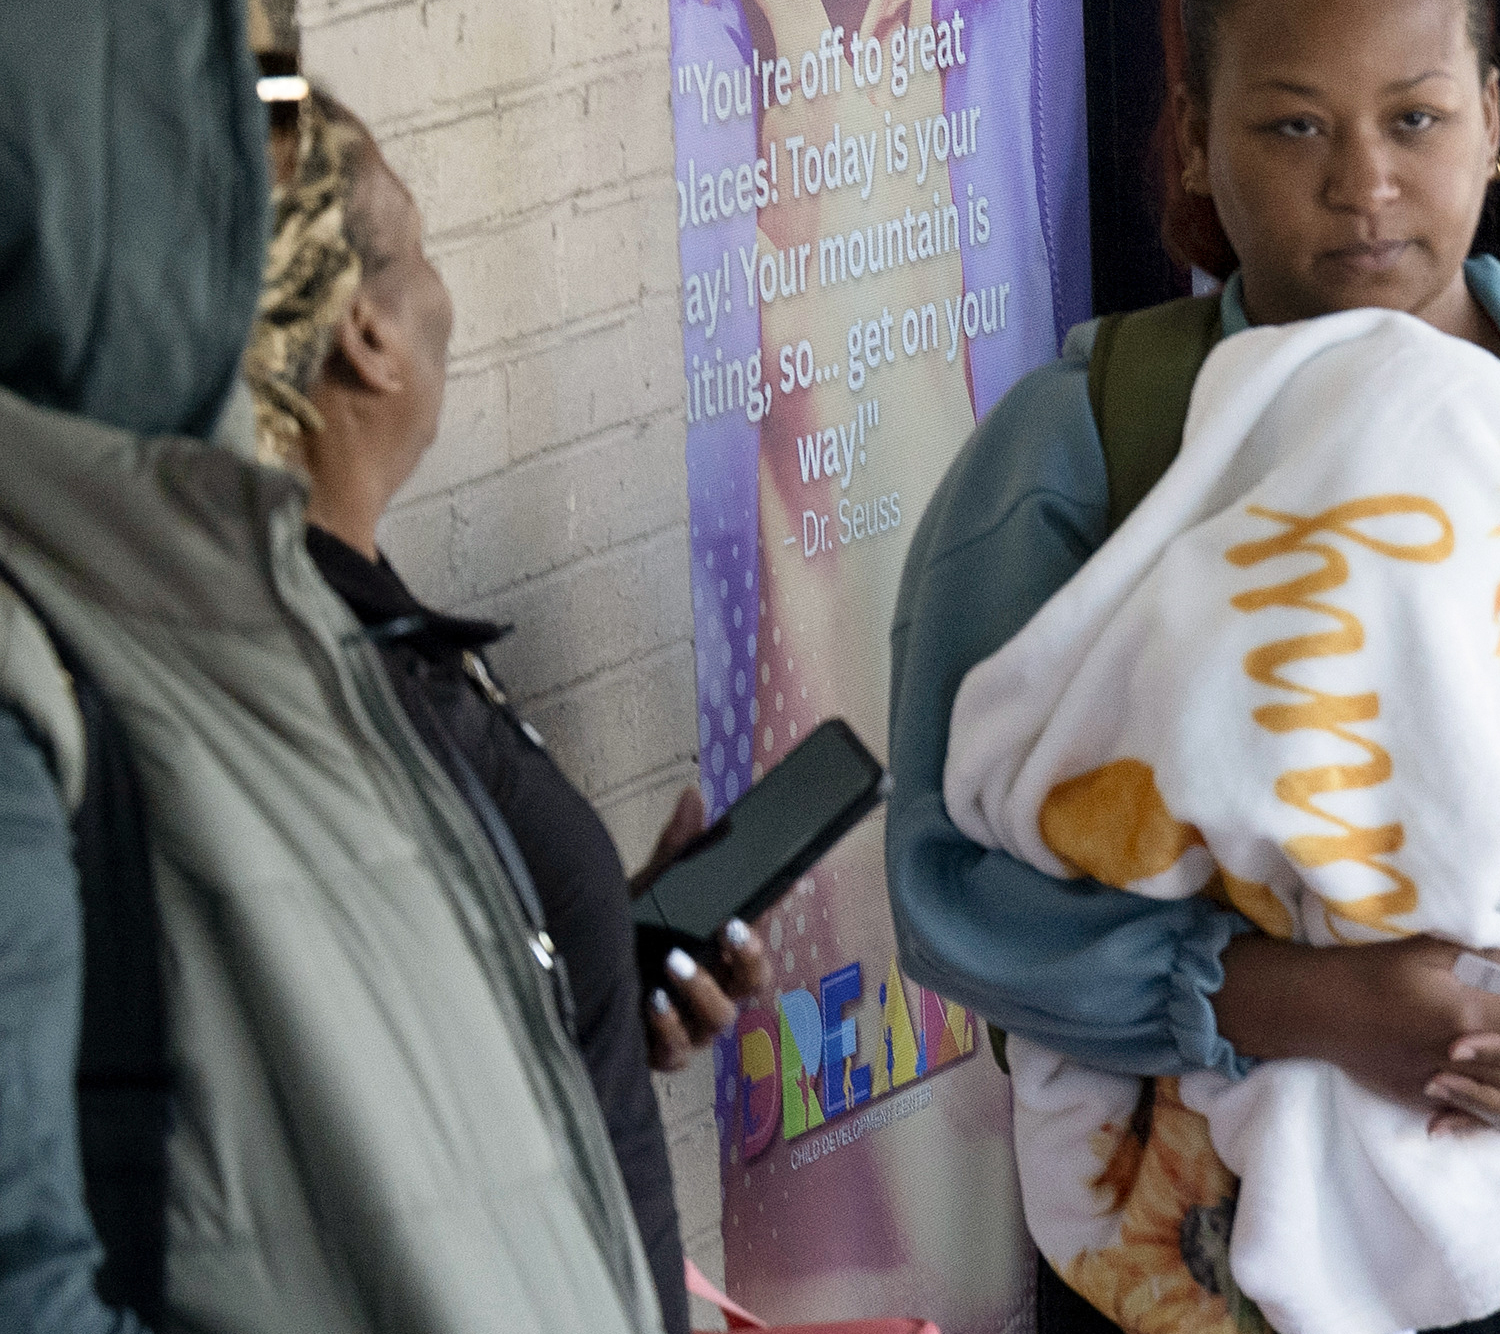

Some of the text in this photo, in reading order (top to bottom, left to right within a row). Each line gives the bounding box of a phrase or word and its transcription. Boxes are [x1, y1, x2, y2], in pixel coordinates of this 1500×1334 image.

[677, 10, 966, 125] "You're off to great
[785, 123, 877, 200] Today
[884, 111, 909, 174] is
[915, 106, 981, 186] your
[685, 183, 991, 338] ay! Your mountain is
[687, 282, 1011, 424] iting, so... get on your
[797, 399, 879, 489] way!"
[802, 509, 833, 558] Dr.
[838, 491, 901, 544] Seuss
[789, 1139, 821, 1170] CHILD
